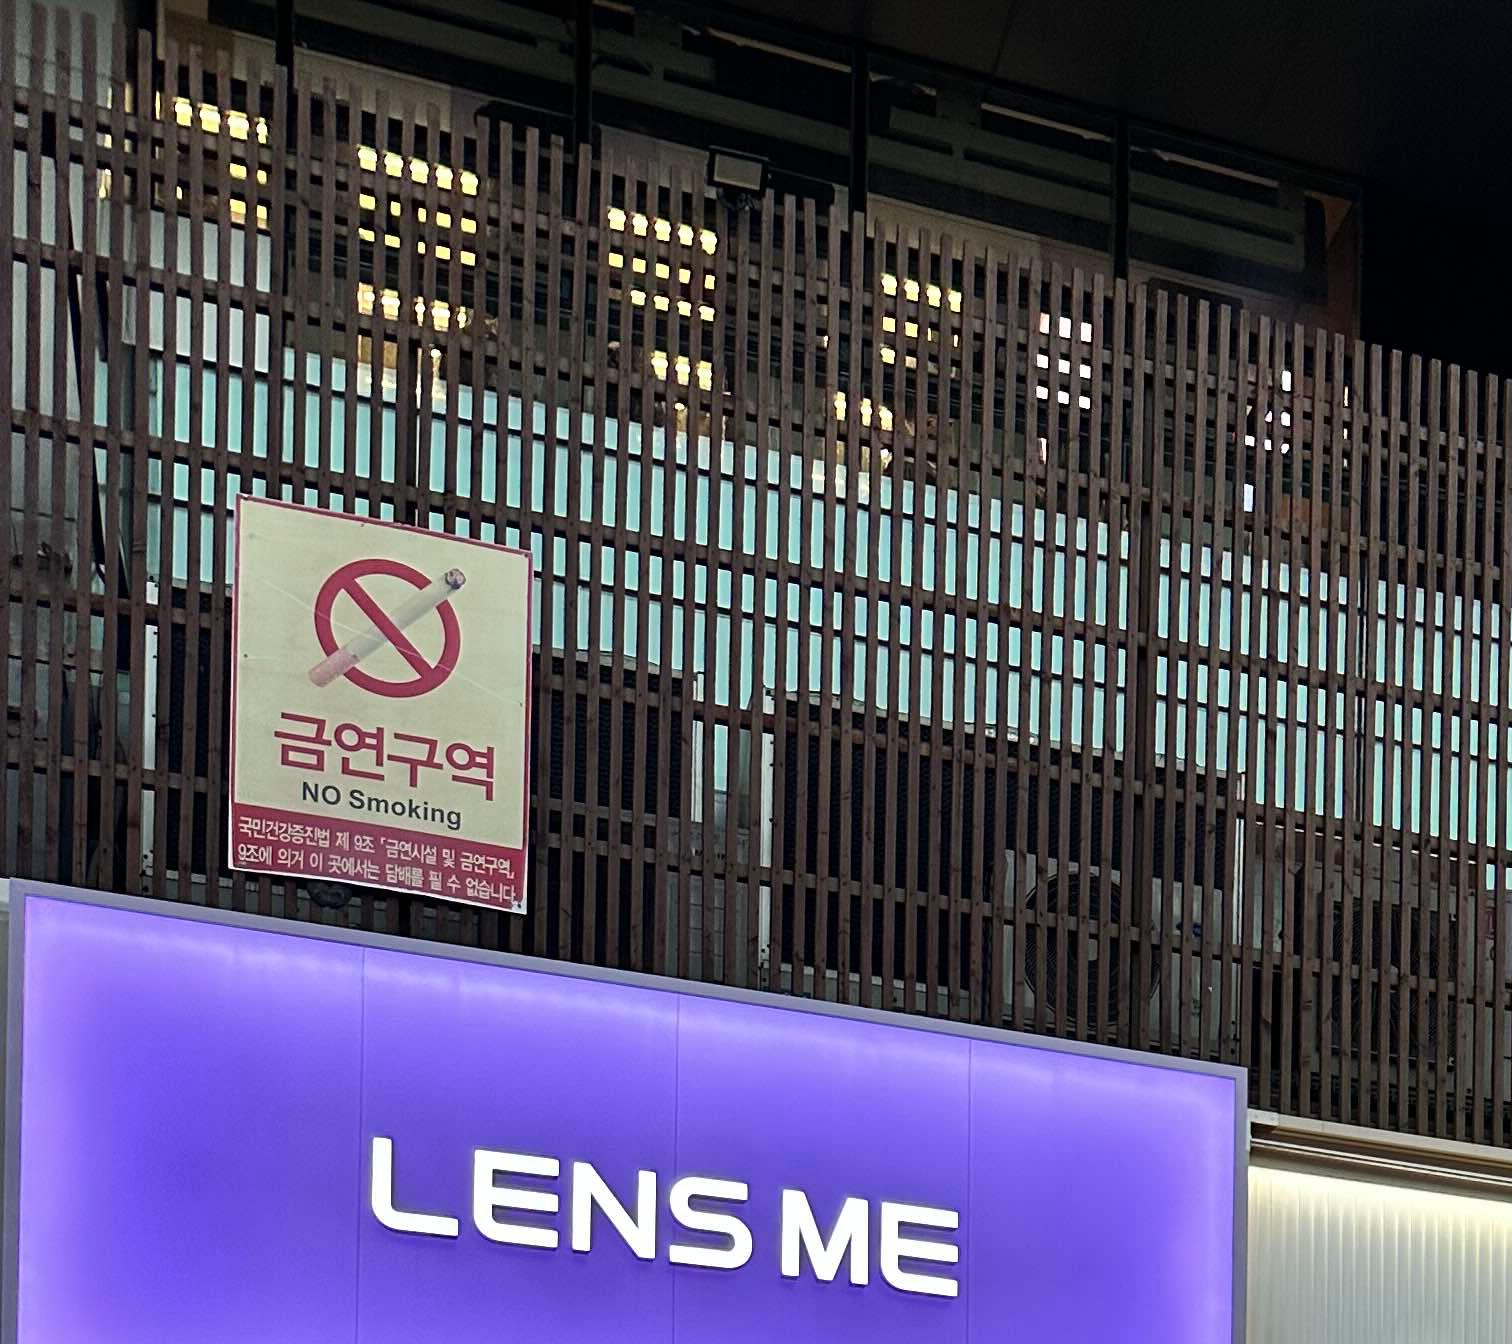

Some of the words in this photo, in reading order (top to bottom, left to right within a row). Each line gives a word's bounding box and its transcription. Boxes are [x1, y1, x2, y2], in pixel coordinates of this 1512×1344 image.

[274, 712, 495, 801] 금연구역
[302, 782, 341, 805] NO
[350, 789, 461, 830] Smoking
[238, 816, 330, 848] 국민건강증진법
[336, 832, 349, 850] 제
[354, 835, 375, 853] 9조
[442, 849, 455, 868] 및
[238, 844, 272, 866] 9조에
[278, 849, 303, 870] 의거
[310, 853, 323, 870] 이
[328, 854, 380, 880] 곳에서는
[386, 863, 423, 887] 담배를
[428, 872, 442, 891] 필
[447, 874, 460, 893] 수
[370, 1136, 755, 1272] LENS
[780, 1187, 962, 1299] ME
